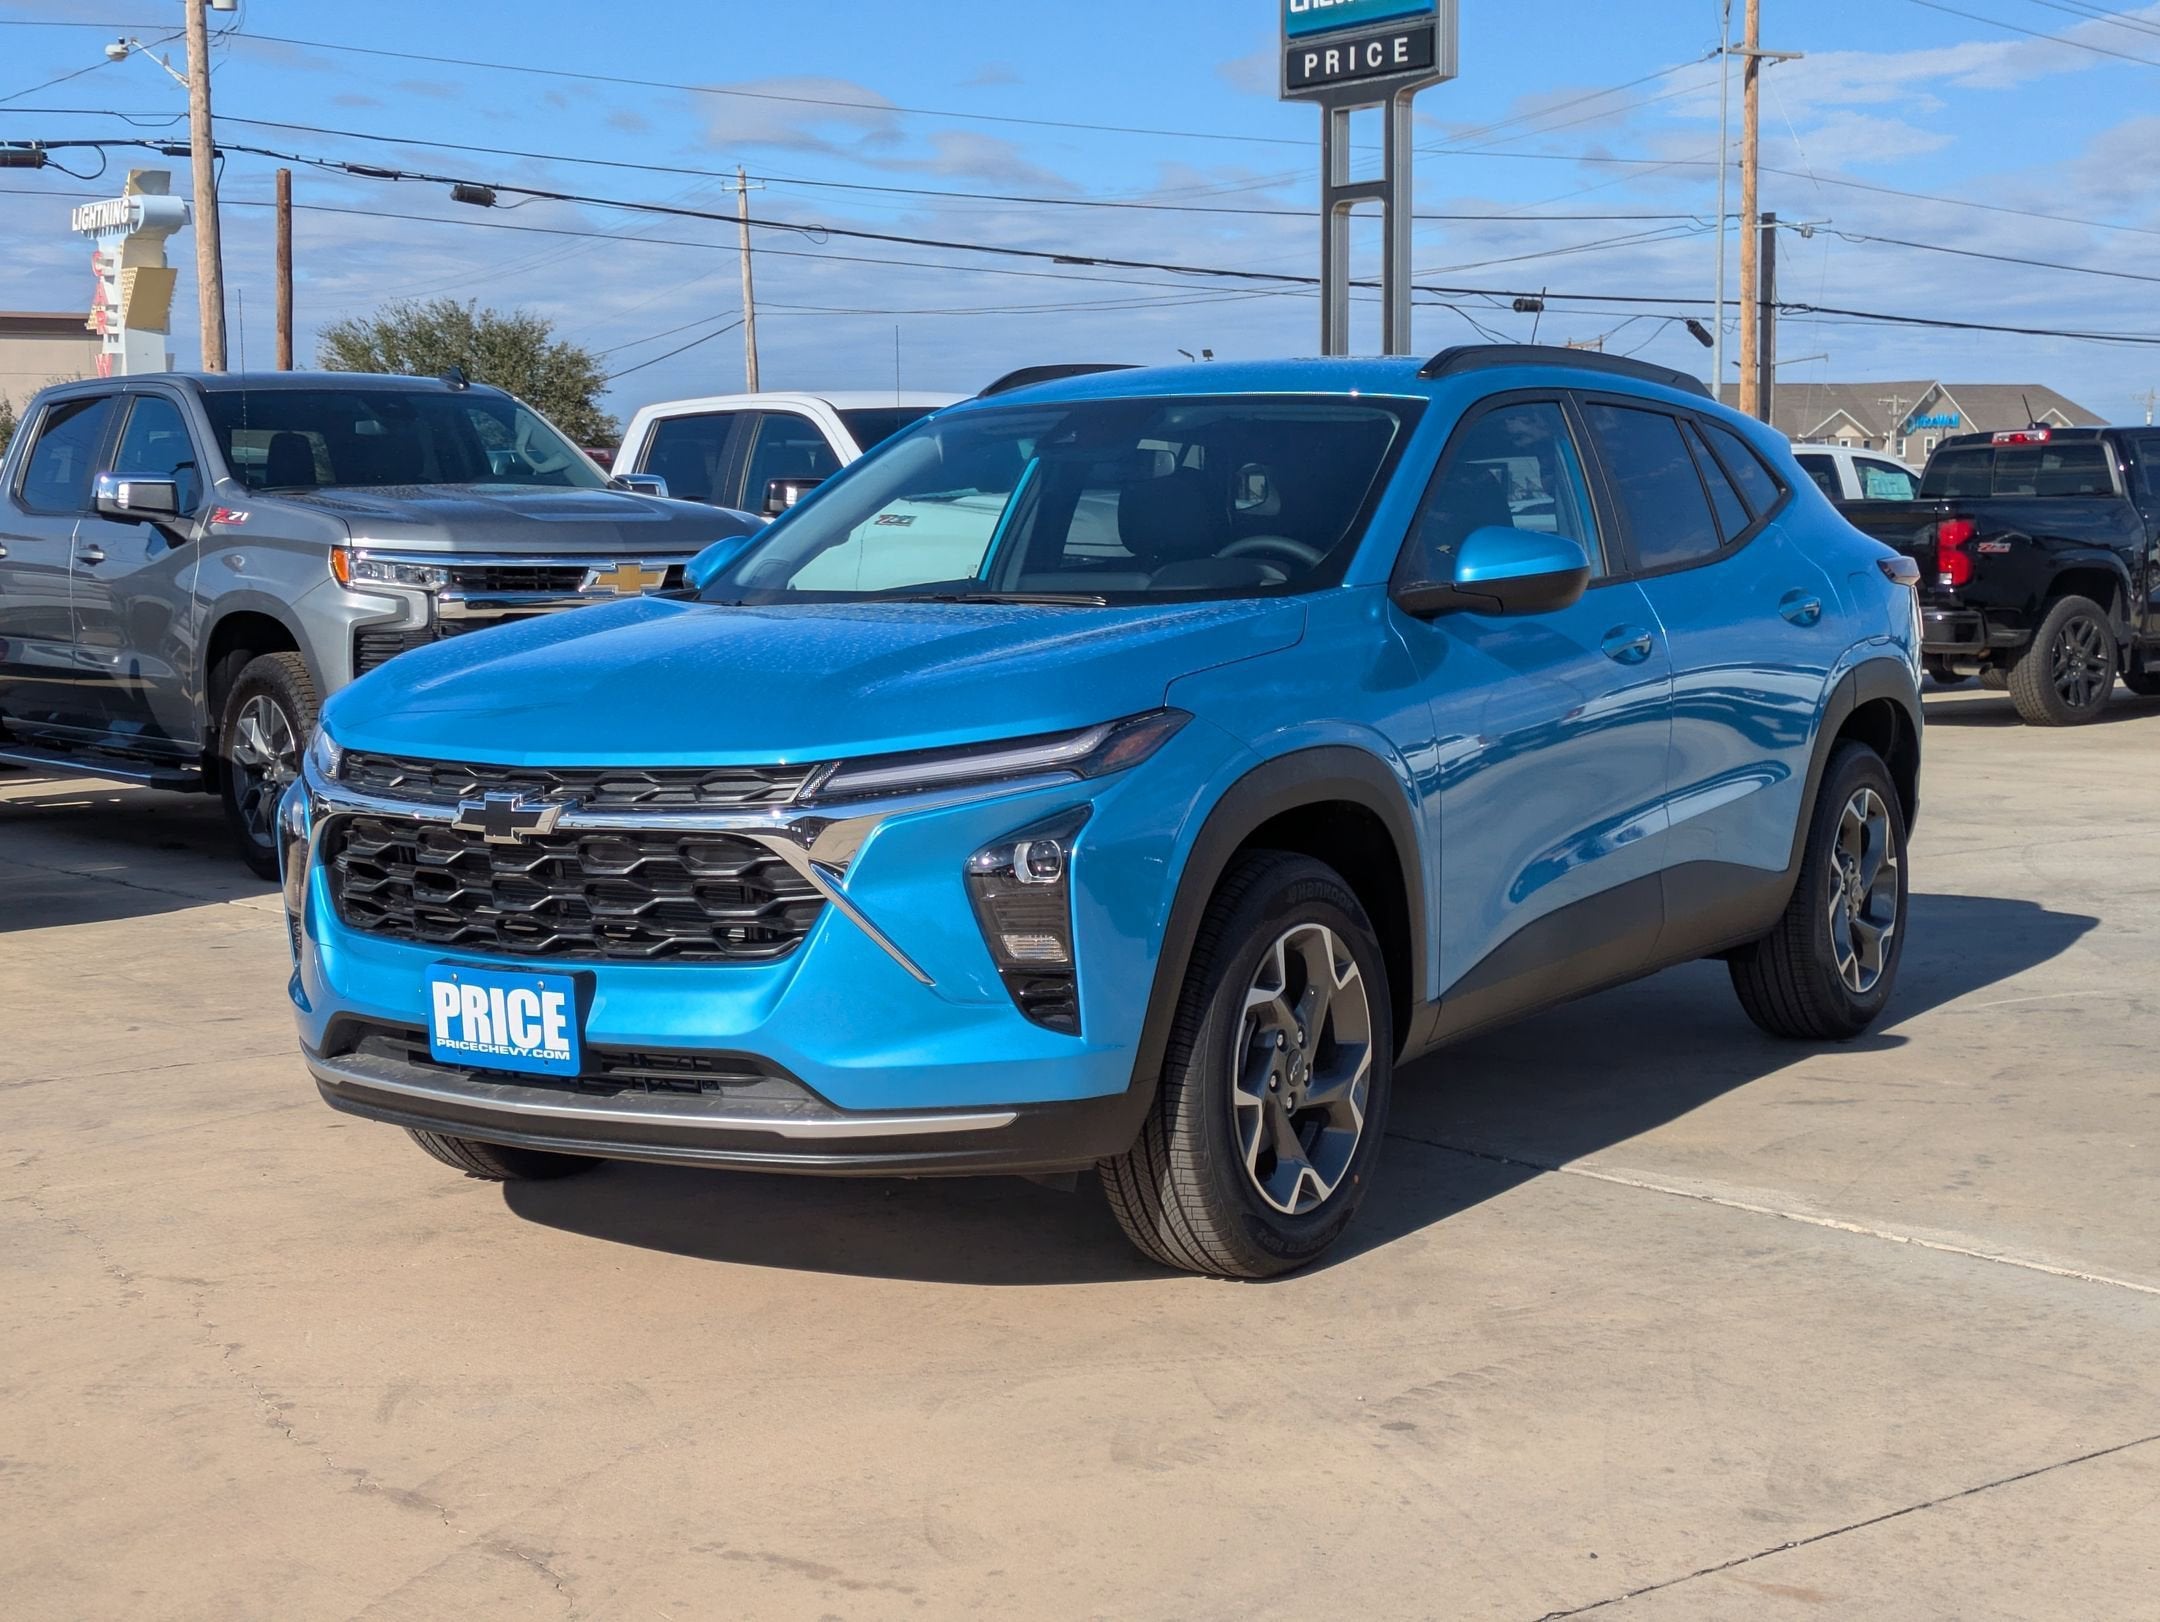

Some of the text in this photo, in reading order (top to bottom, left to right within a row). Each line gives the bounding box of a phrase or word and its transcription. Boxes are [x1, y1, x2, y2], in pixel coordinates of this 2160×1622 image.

[1304, 37, 1409, 78] PRICE
[72, 200, 130, 232] LIGHTNING
[211, 507, 249, 525] Z71
[432, 981, 570, 1051] PRICE
[437, 1038, 570, 1060] PRICECHEVY.COM
